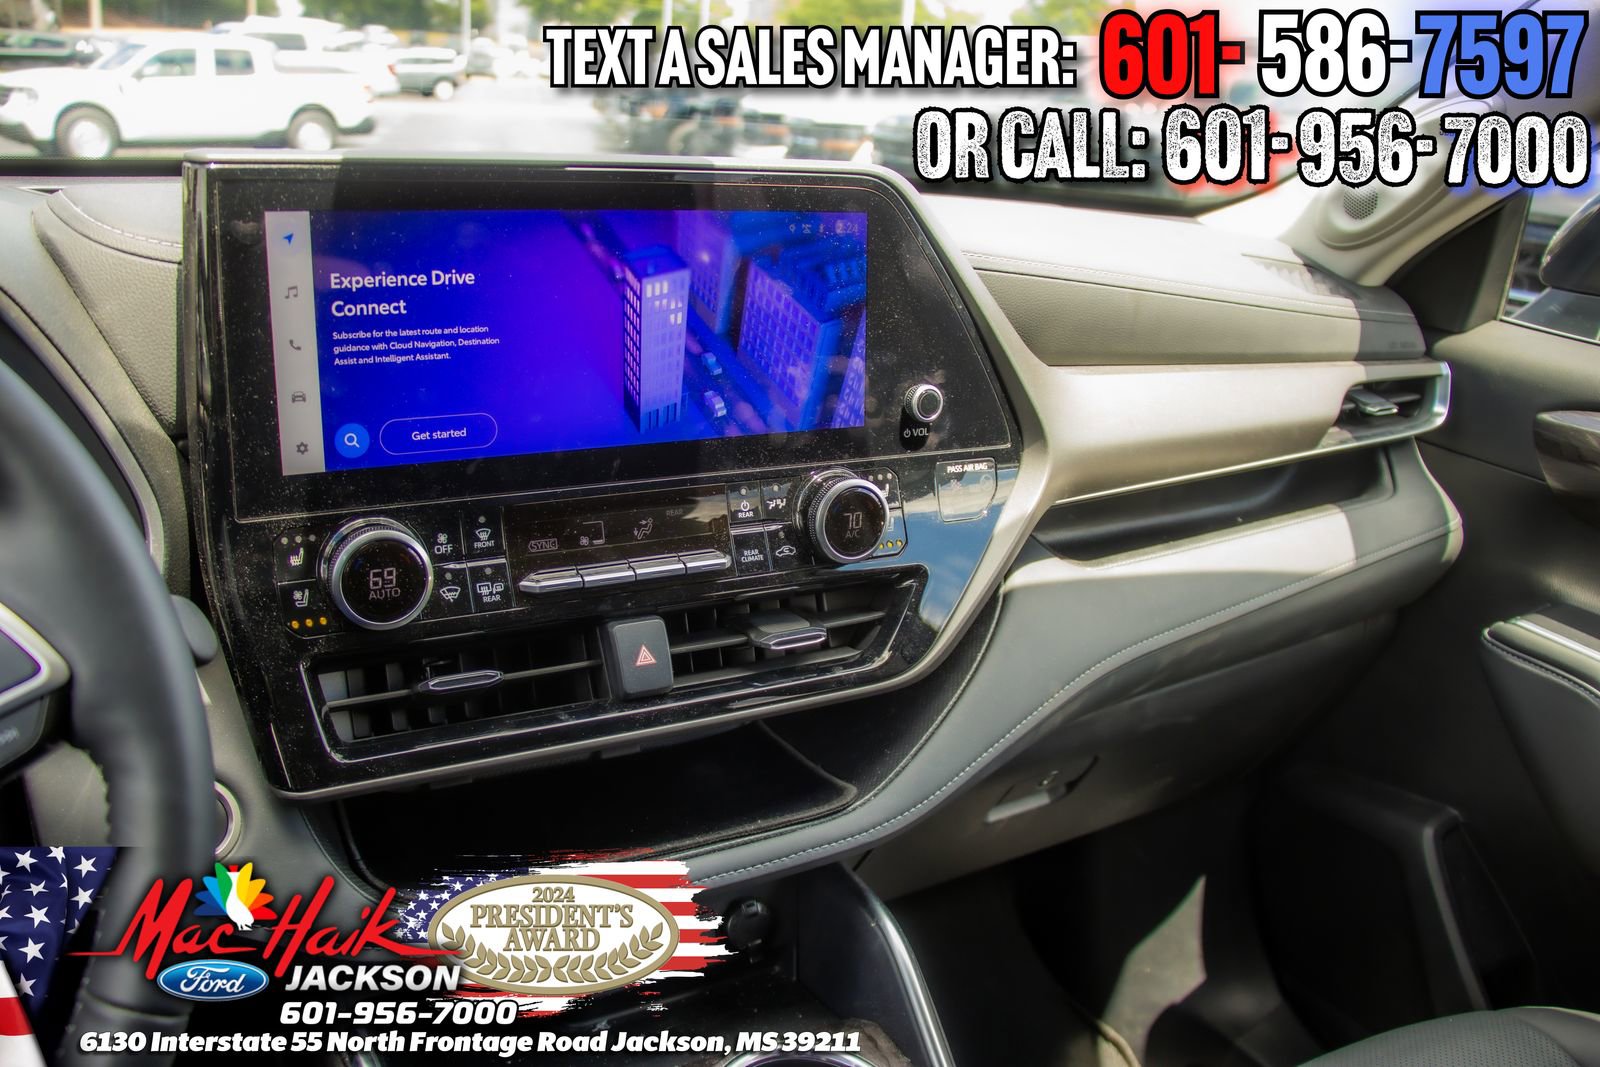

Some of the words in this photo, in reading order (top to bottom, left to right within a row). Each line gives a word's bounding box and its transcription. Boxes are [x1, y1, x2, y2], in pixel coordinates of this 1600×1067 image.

[329, 272, 427, 291] Experience
[431, 269, 475, 286] Drive
[331, 300, 407, 316] Connect
[332, 330, 372, 340] Subscribe
[372, 329, 384, 338] for
[385, 328, 398, 337] the
[399, 328, 421, 336] latest
[421, 327, 442, 335] route
[443, 326, 459, 334] and
[459, 325, 489, 333] location
[333, 344, 370, 355] guidance
[371, 342, 389, 351] with
[389, 340, 413, 350] Cloud
[414, 340, 457, 349] Navigation,
[458, 337, 500, 347] Destination
[334, 357, 358, 366] Assist
[358, 356, 374, 364] and
[374, 354, 415, 364] Intelligent
[415, 352, 452, 361] Assistant.
[411, 431, 430, 441] Get
[432, 428, 467, 439] started
[912, 427, 929, 437] VOL
[947, 464, 963, 473] PASS
[963, 463, 974, 472] AIR
[974, 462, 988, 471] BAG
[843, 511, 863, 529] 70
[845, 530, 861, 538] A/C
[434, 544, 453, 554] OFF
[474, 540, 495, 549] FRONT
[530, 541, 557, 551] SYNC
[743, 549, 759, 557] REAR
[741, 555, 764, 563] CLIMATE
[369, 567, 397, 590] 69
[369, 588, 400, 600] AUTO
[483, 594, 501, 603] REAR
